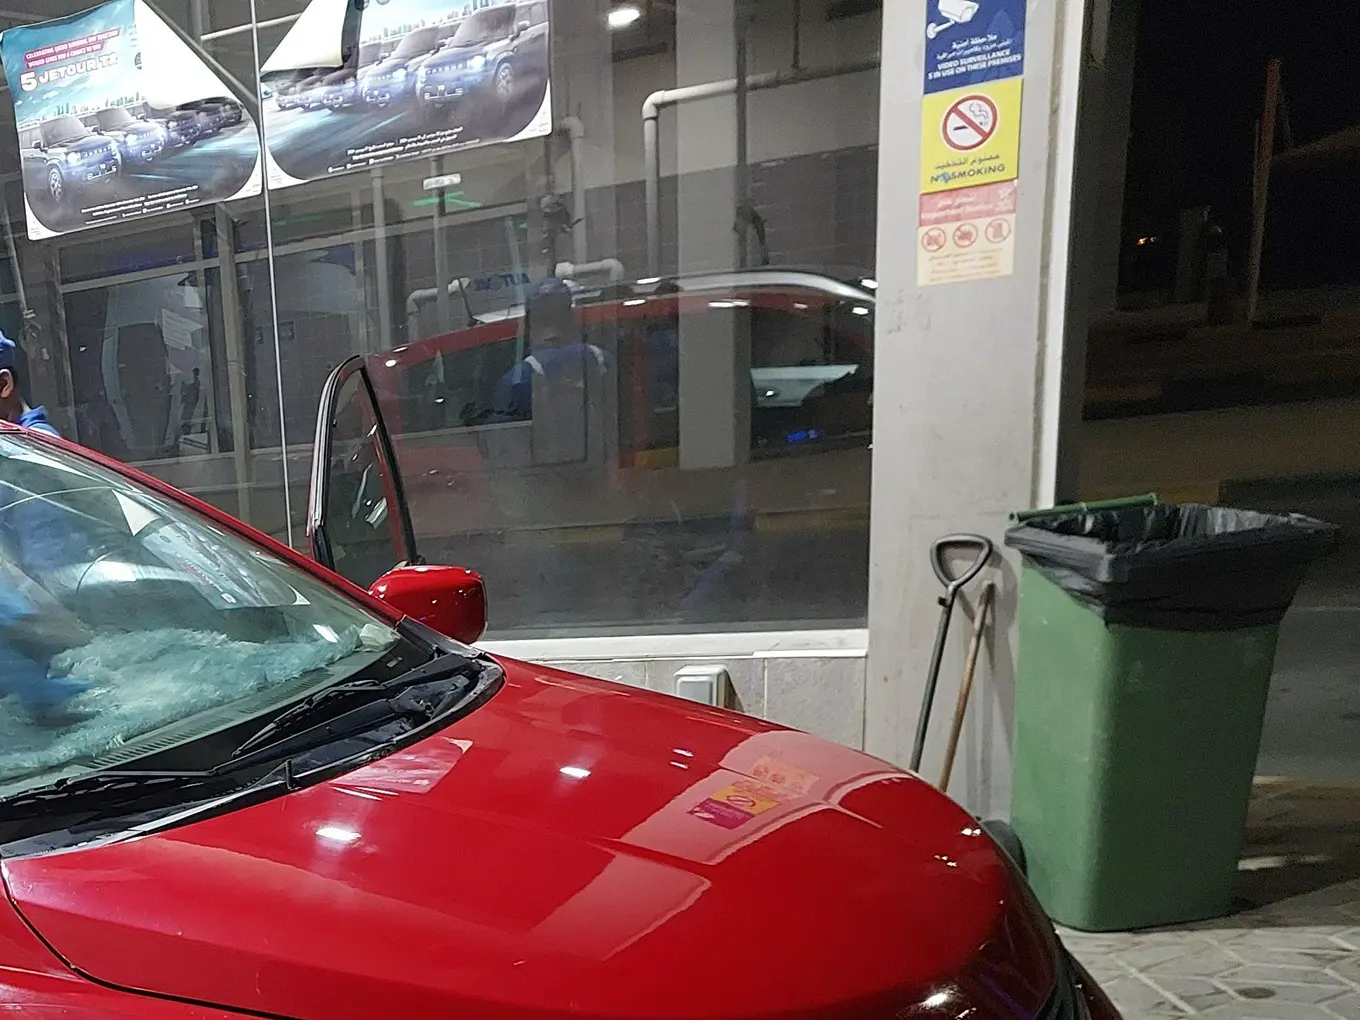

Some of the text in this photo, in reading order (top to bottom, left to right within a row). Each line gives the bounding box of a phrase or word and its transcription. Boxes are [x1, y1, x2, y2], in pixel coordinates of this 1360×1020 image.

[937, 48, 1011, 70] VIDEO SURVEILLANCE
[941, 67, 955, 77] USE
[955, 65, 967, 74] ON
[966, 60, 987, 72] THESE
[987, 53, 1022, 68] PREMISES
[20, 71, 38, 92] 5
[38, 58, 97, 83] JETOUR
[950, 164, 1005, 179] SMOKING
